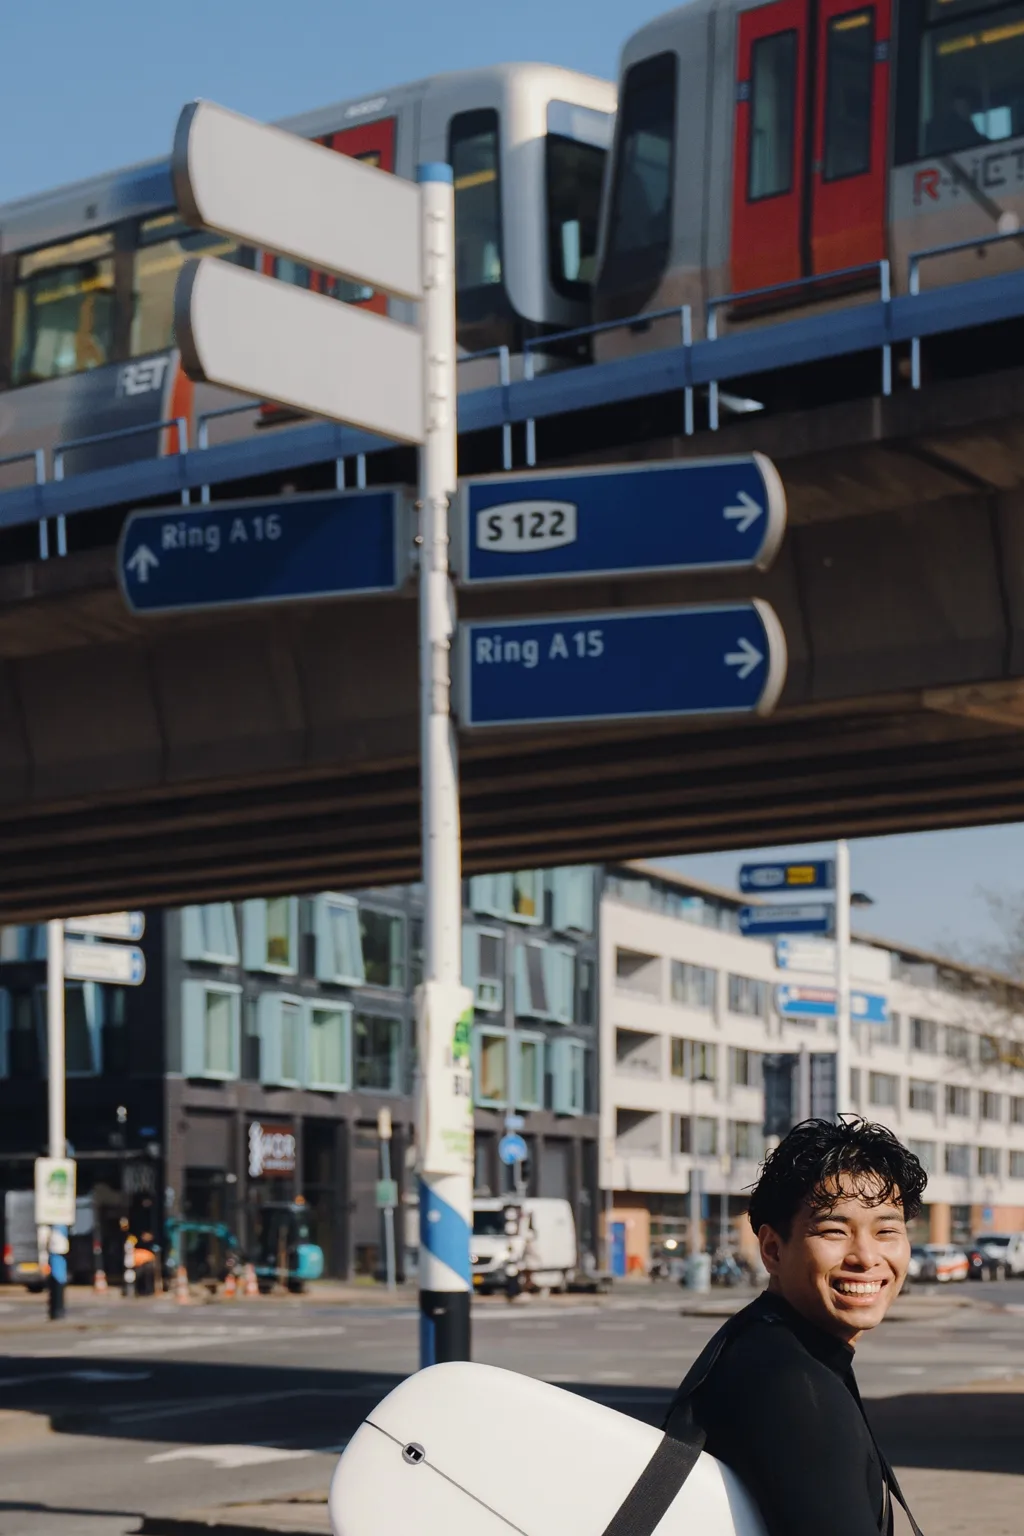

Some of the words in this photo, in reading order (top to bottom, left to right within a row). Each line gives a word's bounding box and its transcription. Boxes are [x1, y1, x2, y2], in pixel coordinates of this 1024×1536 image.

[115, 356, 169, 399] RET
[161, 521, 221, 553] Ring
[475, 635, 539, 669] Ring
